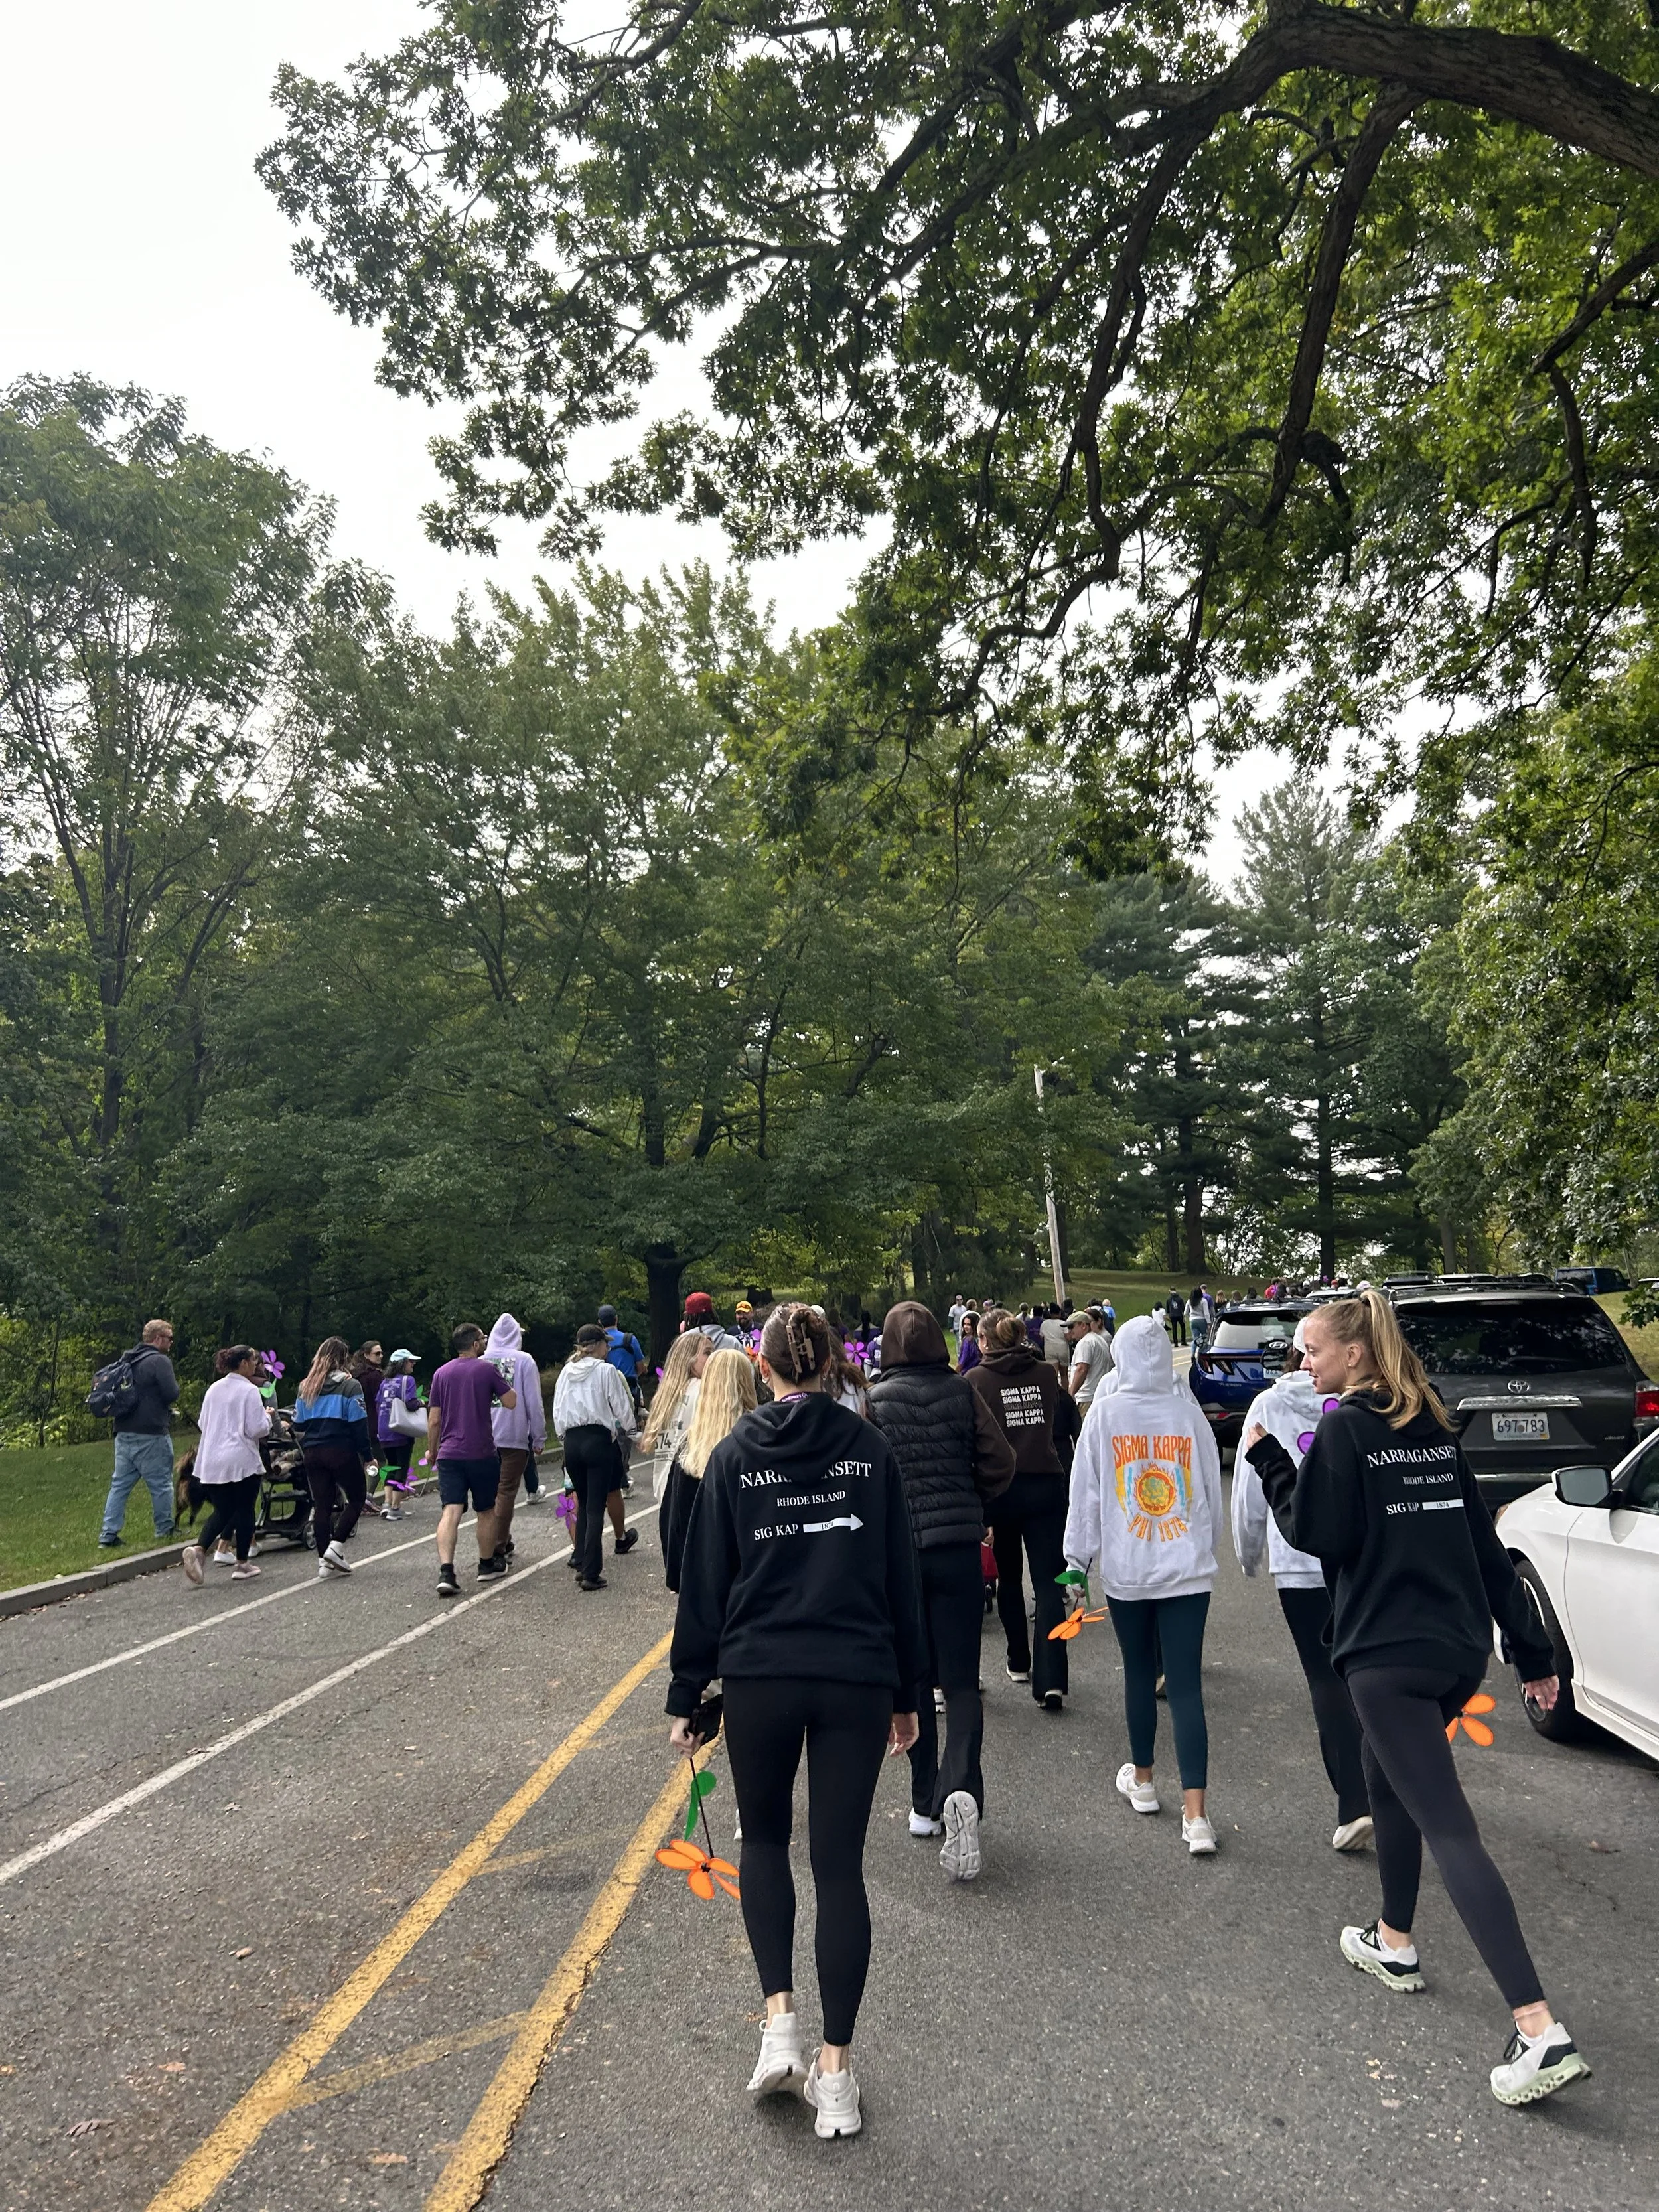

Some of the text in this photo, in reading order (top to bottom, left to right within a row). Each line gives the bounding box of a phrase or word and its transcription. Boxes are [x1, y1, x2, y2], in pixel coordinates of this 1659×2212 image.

[1000, 1388, 1019, 1396] SIGMA
[1003, 1395, 1021, 1404] SIGMA
[1005, 1408, 1044, 1420] SIGMA KAPPA
[1007, 1418, 1025, 1427] SIGMA
[1497, 1419, 1545, 1432] 697 783
[1112, 1435, 1192, 1470] SIGMA KAPPA
[1425, 1473, 1453, 1484] ISLAND
[776, 1491, 845, 1507] RHODE ISLAND
[1386, 1503, 1406, 1515] SIG
[1407, 1502, 1419, 1512] KAP
[754, 1527, 772, 1540] SIG
[776, 1524, 798, 1536] KAP
[1128, 1513, 1188, 1542] PHI 1874
